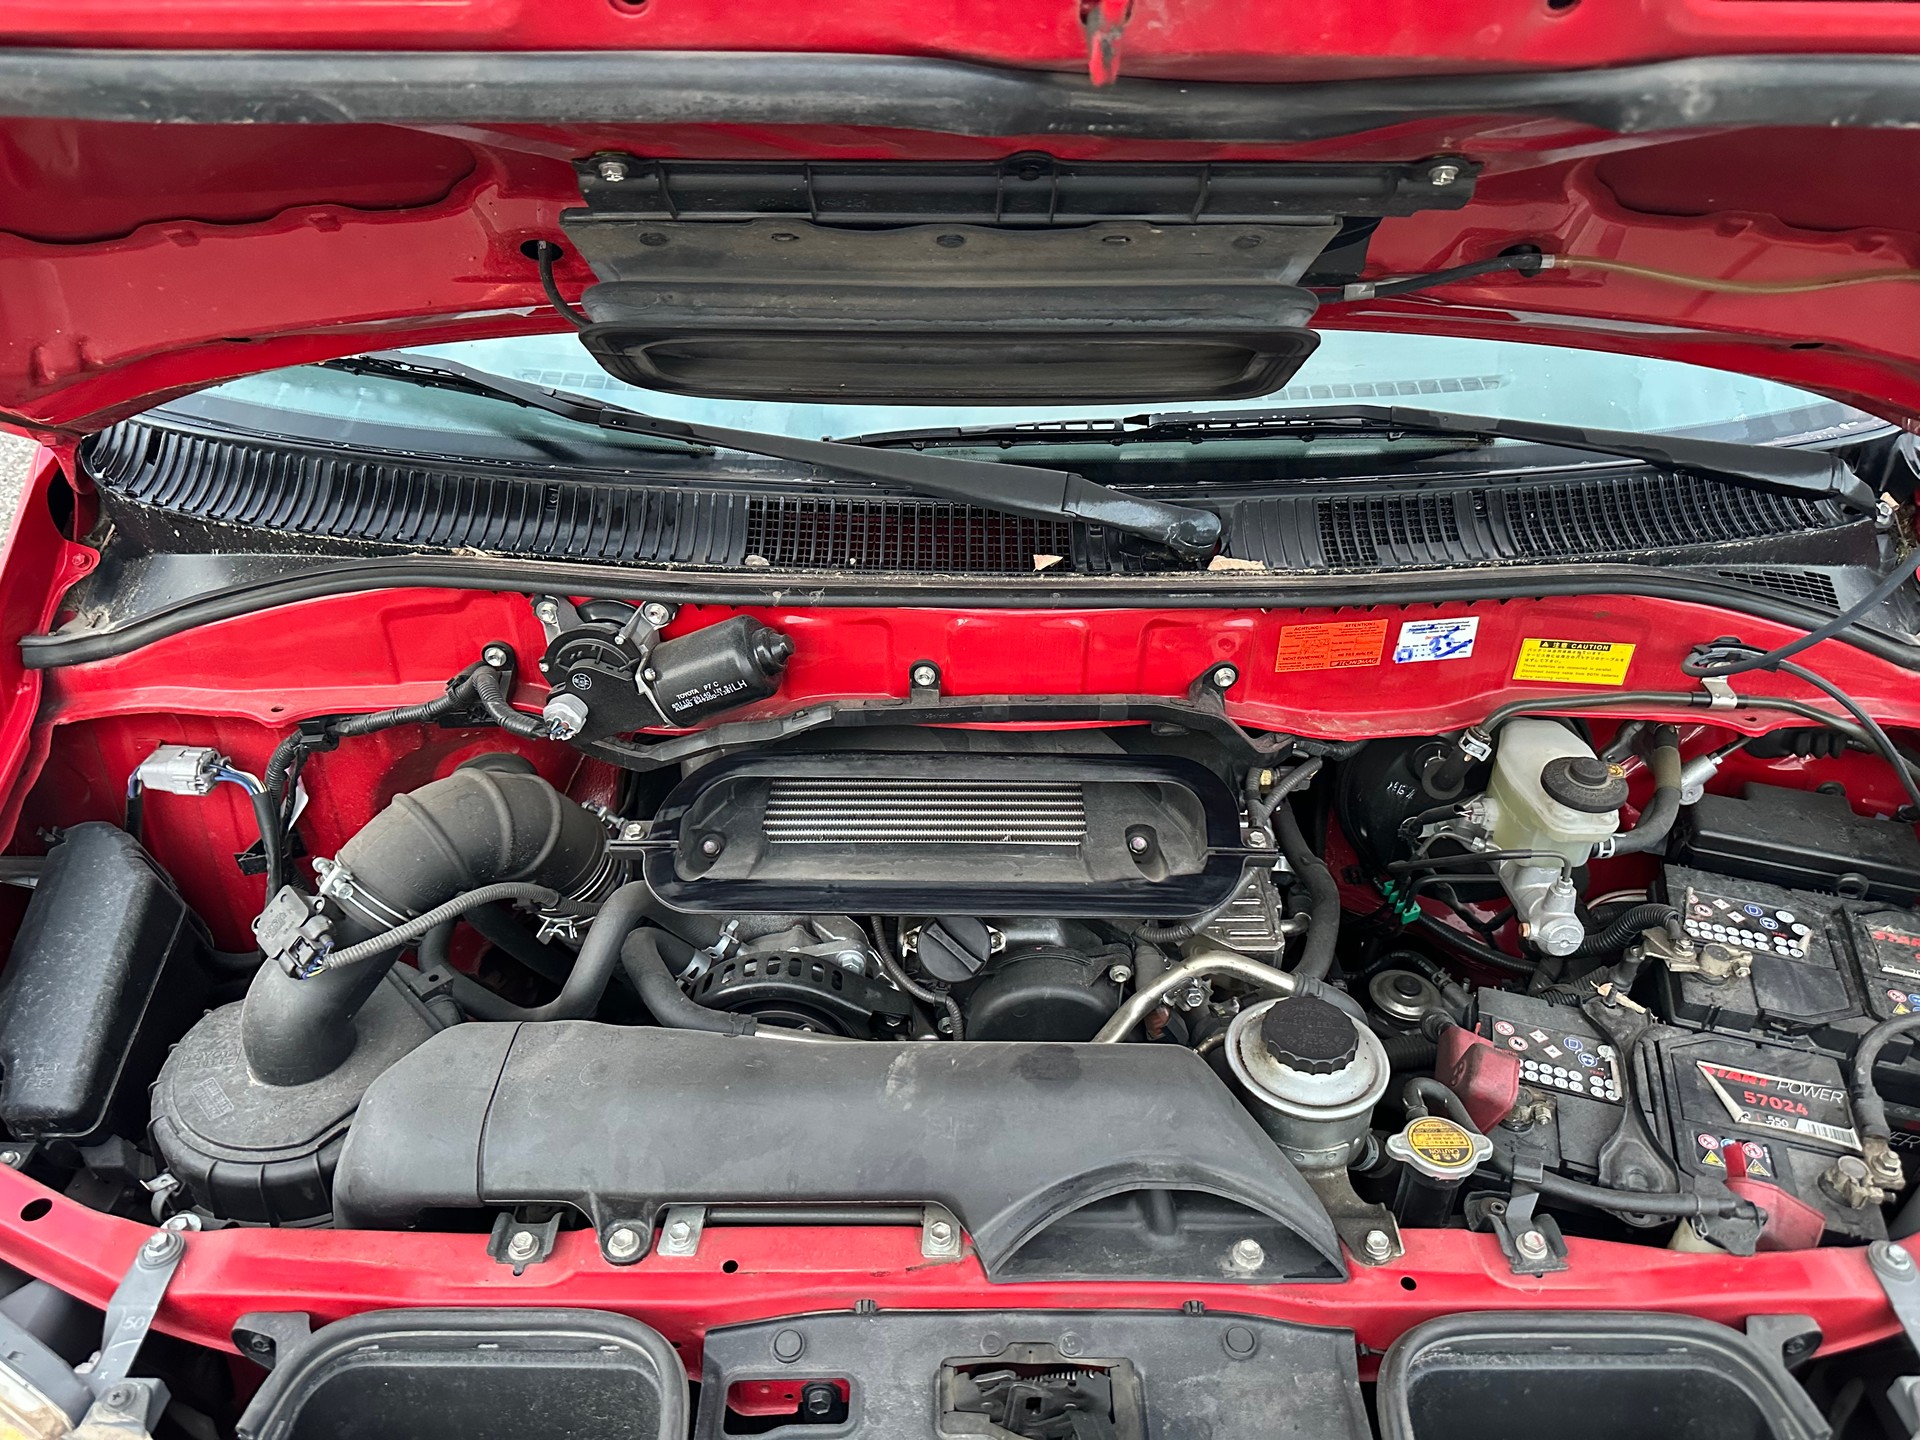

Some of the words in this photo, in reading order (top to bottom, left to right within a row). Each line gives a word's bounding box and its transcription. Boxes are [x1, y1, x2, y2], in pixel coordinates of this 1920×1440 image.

[1571, 643, 1609, 651] CAUTION
[676, 688, 700, 700] TOYOTA
[1777, 1080, 1844, 1104] POWER
[1743, 1090, 1809, 1116] 57024
